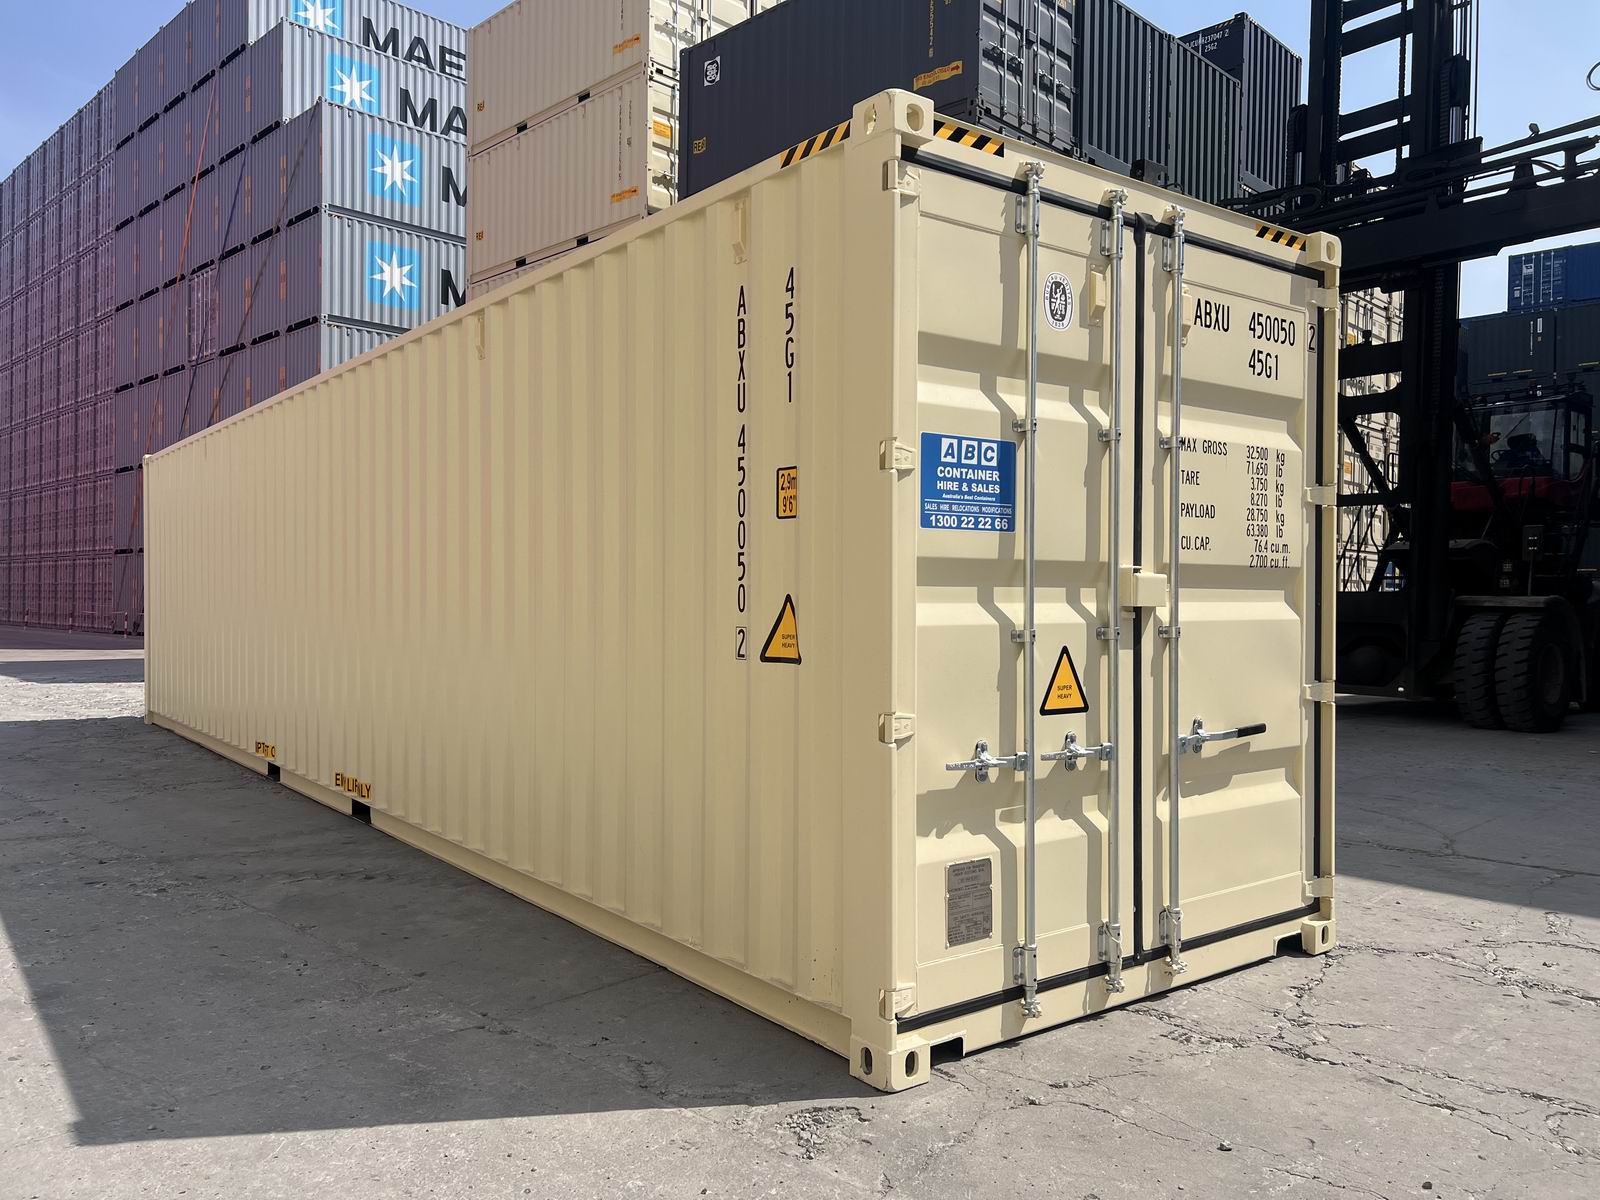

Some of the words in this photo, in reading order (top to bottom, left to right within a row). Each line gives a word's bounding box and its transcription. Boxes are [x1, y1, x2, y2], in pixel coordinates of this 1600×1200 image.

[785, 267, 795, 403] 45G1
[1194, 298, 1230, 332] ABXU
[1249, 312, 1296, 346] 450050
[1308, 325, 1316, 351] 2
[737, 285, 747, 413] ABXU
[1249, 349, 1279, 380] 45G1
[942, 440, 997, 465] ABC
[1180, 437, 1197, 452] MAX
[1202, 439, 1228, 456] GROSS
[1246, 445, 1269, 461] 32.500
[1276, 449, 1286, 466] kg
[937, 466, 1000, 481] CONTAINER
[1181, 469, 1200, 486] TARE
[1250, 476, 1268, 492] 3.750
[1276, 479, 1285, 497] kg
[1276, 464, 1283, 477] lb
[937, 481, 960, 491] HIRE
[962, 483, 969, 492] &
[971, 483, 1001, 494] SALES
[1250, 492, 1268, 507] 8.270
[1276, 494, 1283, 508] lb
[737, 424, 746, 613] 450050
[952, 504, 980, 513] RELOCATIONS
[982, 506, 1012, 514] MODIFICATIONS
[1180, 502, 1216, 519] PAYLOAD
[1246, 507, 1269, 522] 28.750
[1276, 509, 1285, 527] kg
[930, 515, 958, 527] 1300
[961, 516, 975, 528] 22
[978, 518, 992, 529] 22
[995, 518, 1009, 530] 66
[1276, 525, 1284, 538] lb
[1181, 535, 1212, 551] CU.CAP.
[1254, 539, 1268, 553] 76.4
[737, 628, 746, 658] 2
